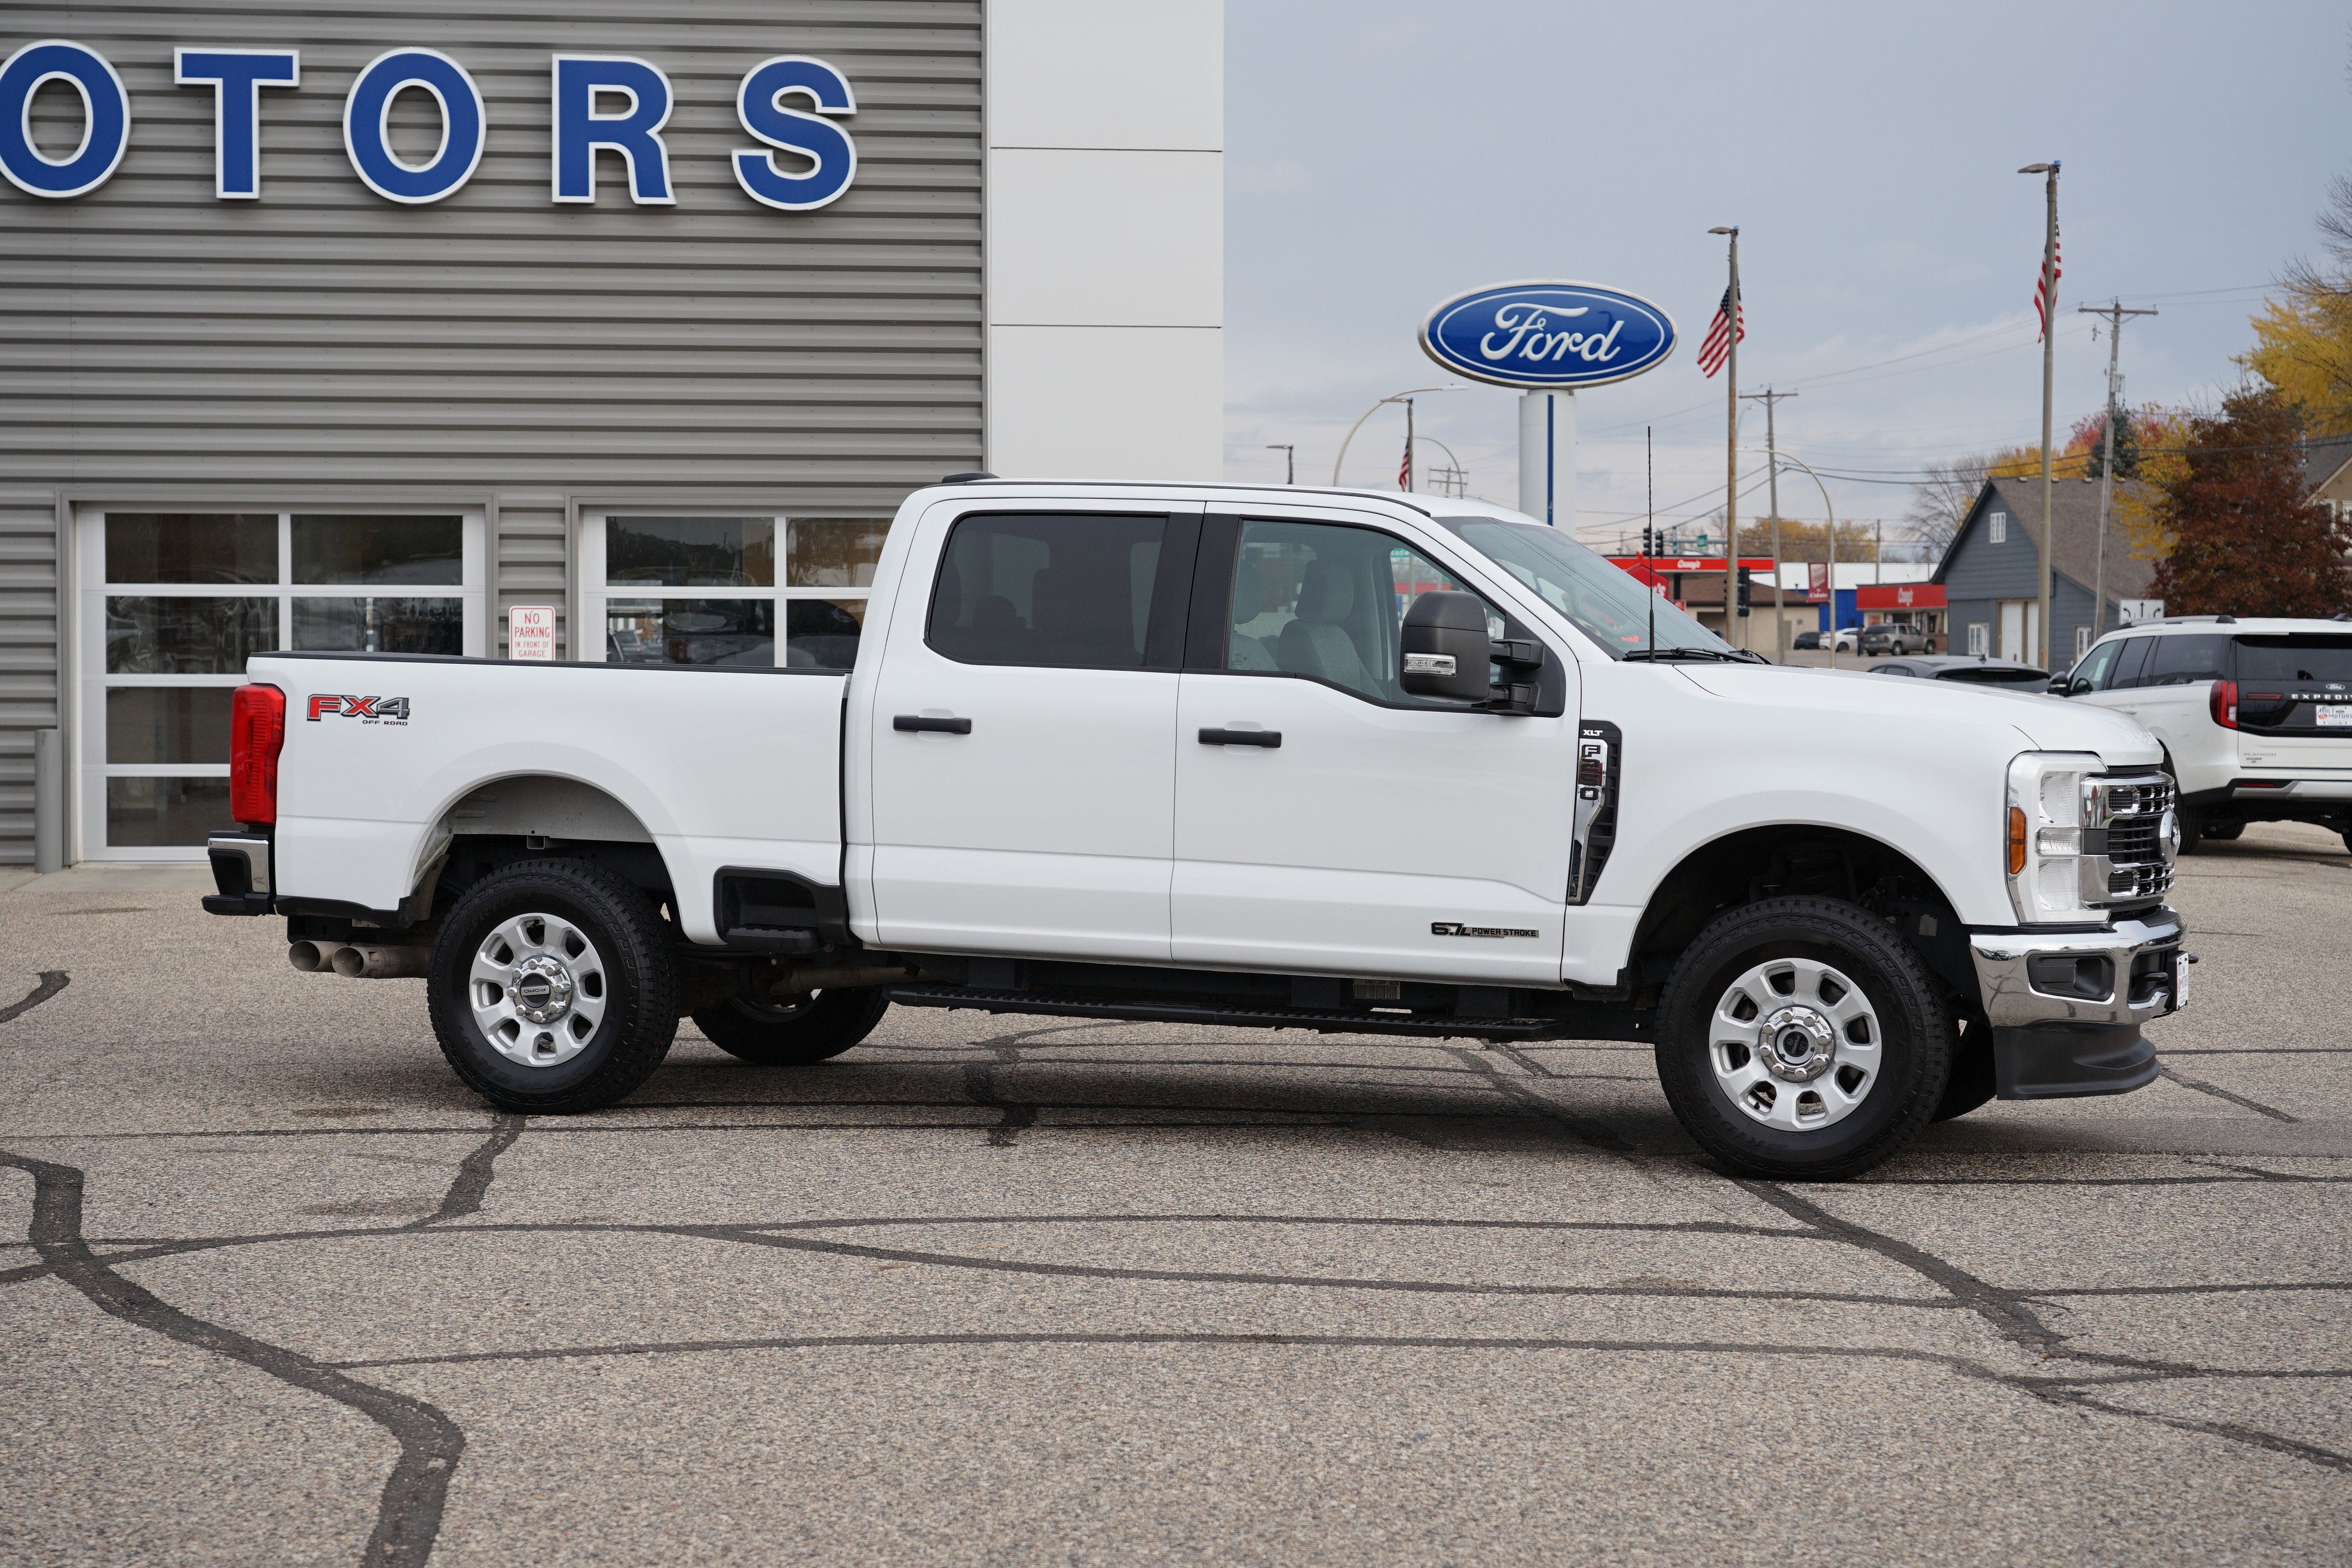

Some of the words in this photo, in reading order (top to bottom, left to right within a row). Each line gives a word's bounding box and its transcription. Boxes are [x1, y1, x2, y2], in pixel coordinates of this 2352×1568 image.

[1480, 302, 1625, 362] Ford
[1677, 559, 1701, 570] Casey's
[525, 613, 540, 624] NO
[514, 627, 550, 638] PARKING
[307, 694, 410, 721] FX4
[1431, 922, 1471, 936] 6.7L
